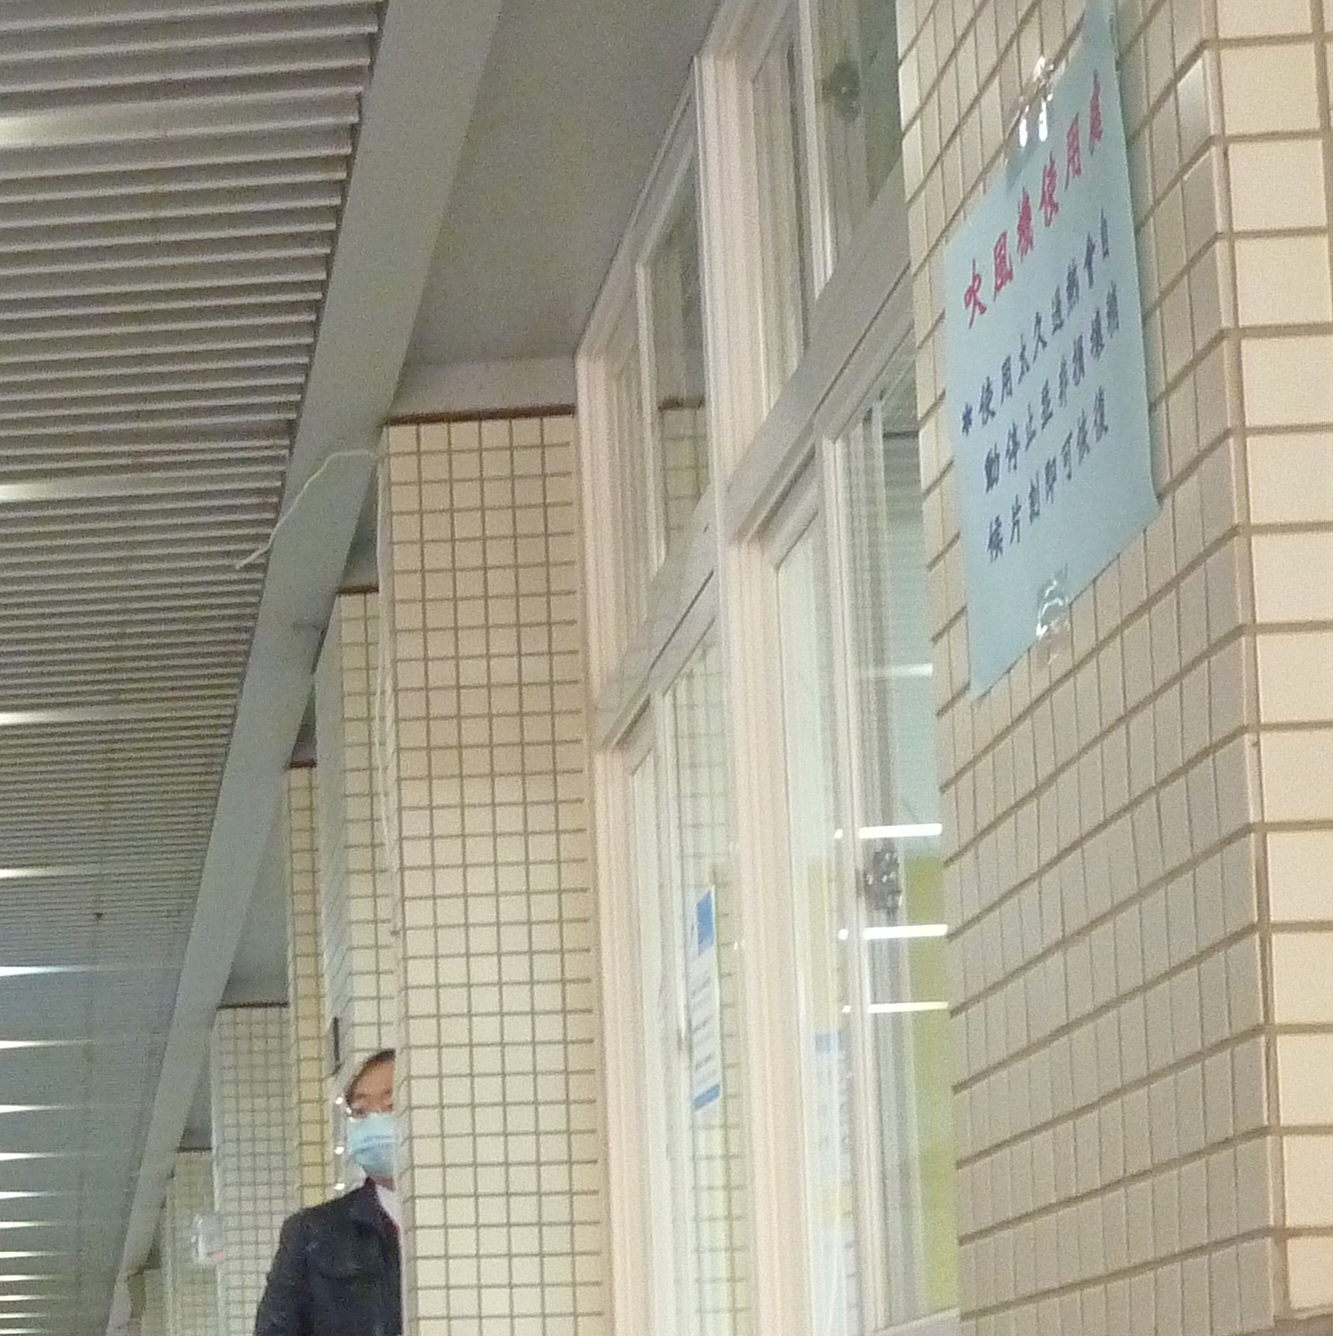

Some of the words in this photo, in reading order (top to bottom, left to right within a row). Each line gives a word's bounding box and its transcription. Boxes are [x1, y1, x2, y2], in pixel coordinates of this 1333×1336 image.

[963, 69, 1103, 330] 吹風機使用處
